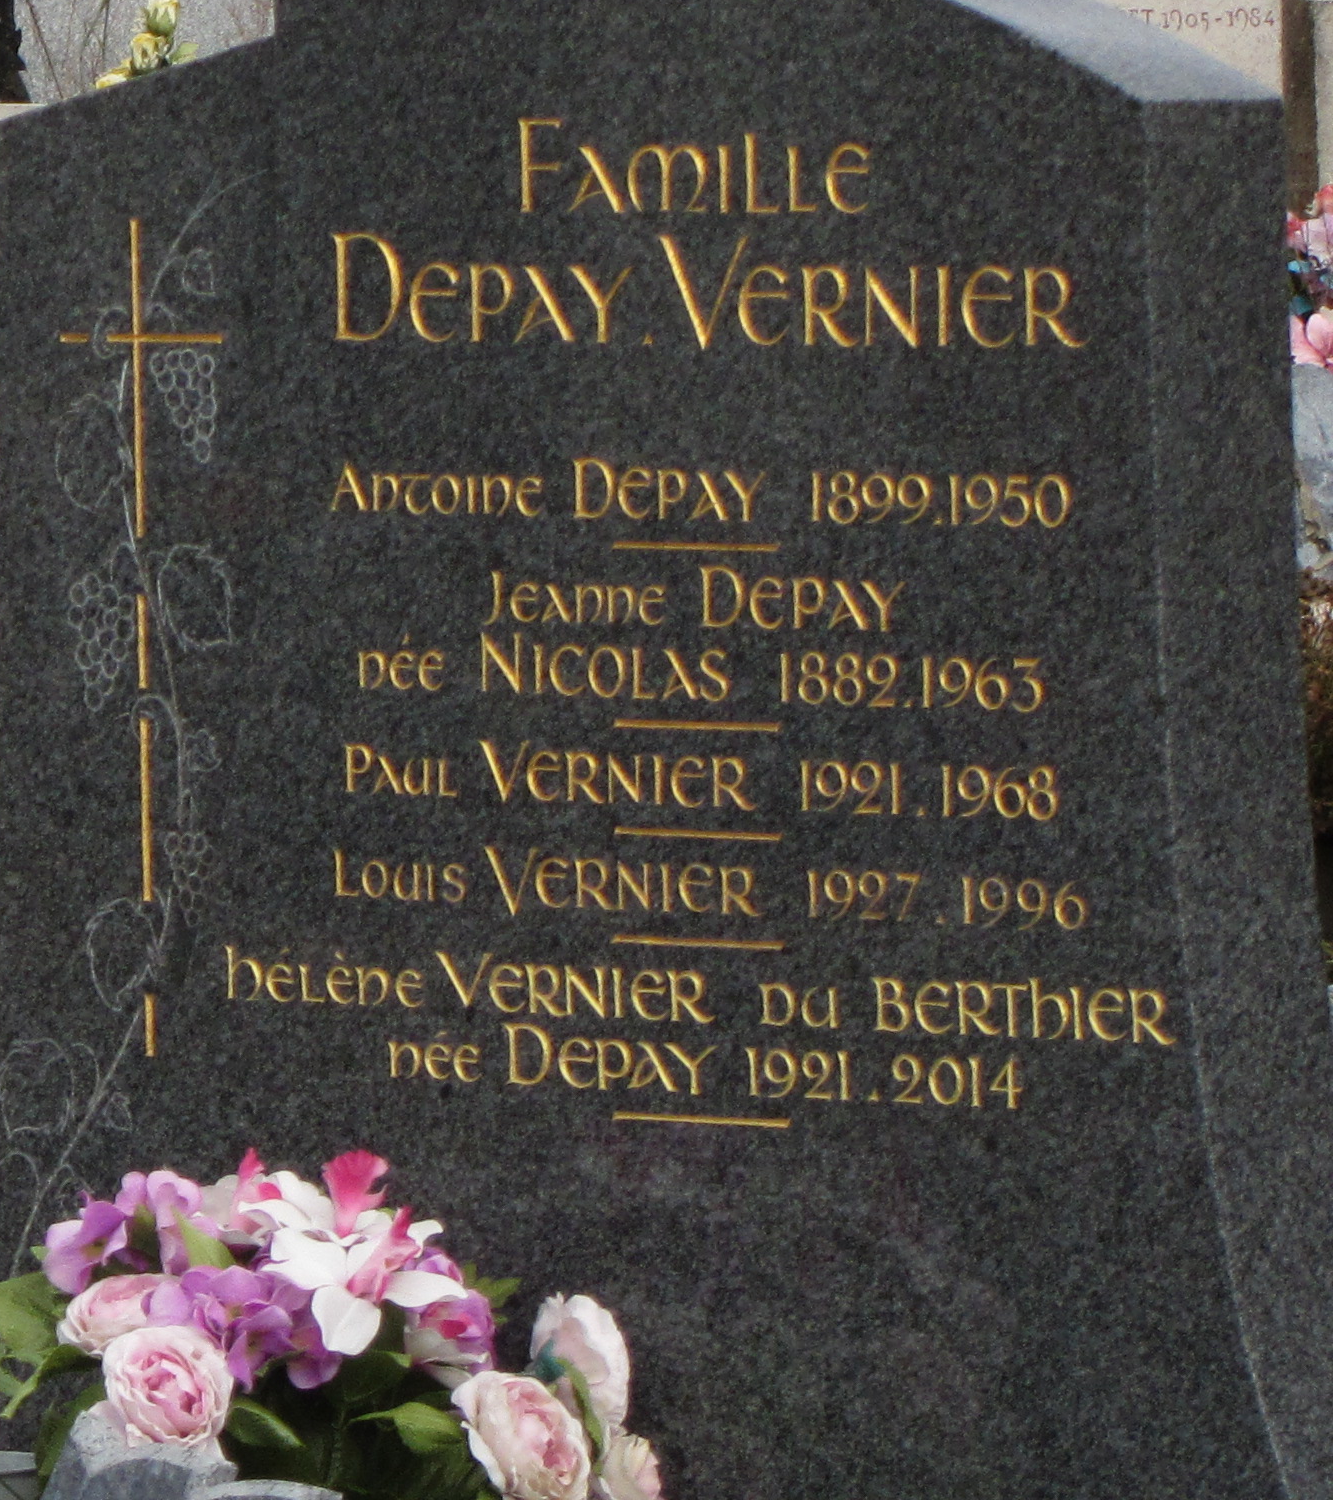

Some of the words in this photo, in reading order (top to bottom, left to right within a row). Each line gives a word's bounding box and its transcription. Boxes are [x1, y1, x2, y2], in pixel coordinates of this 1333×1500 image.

[573, 456, 767, 522] DEPAY
[700, 564, 903, 633] DEPAY
[480, 632, 731, 703] NICOLAS
[478, 738, 754, 812] VERNIER
[484, 845, 758, 918] VERNIER
[434, 950, 715, 1026] VERNIER
[503, 1021, 718, 1097] DEPAY
